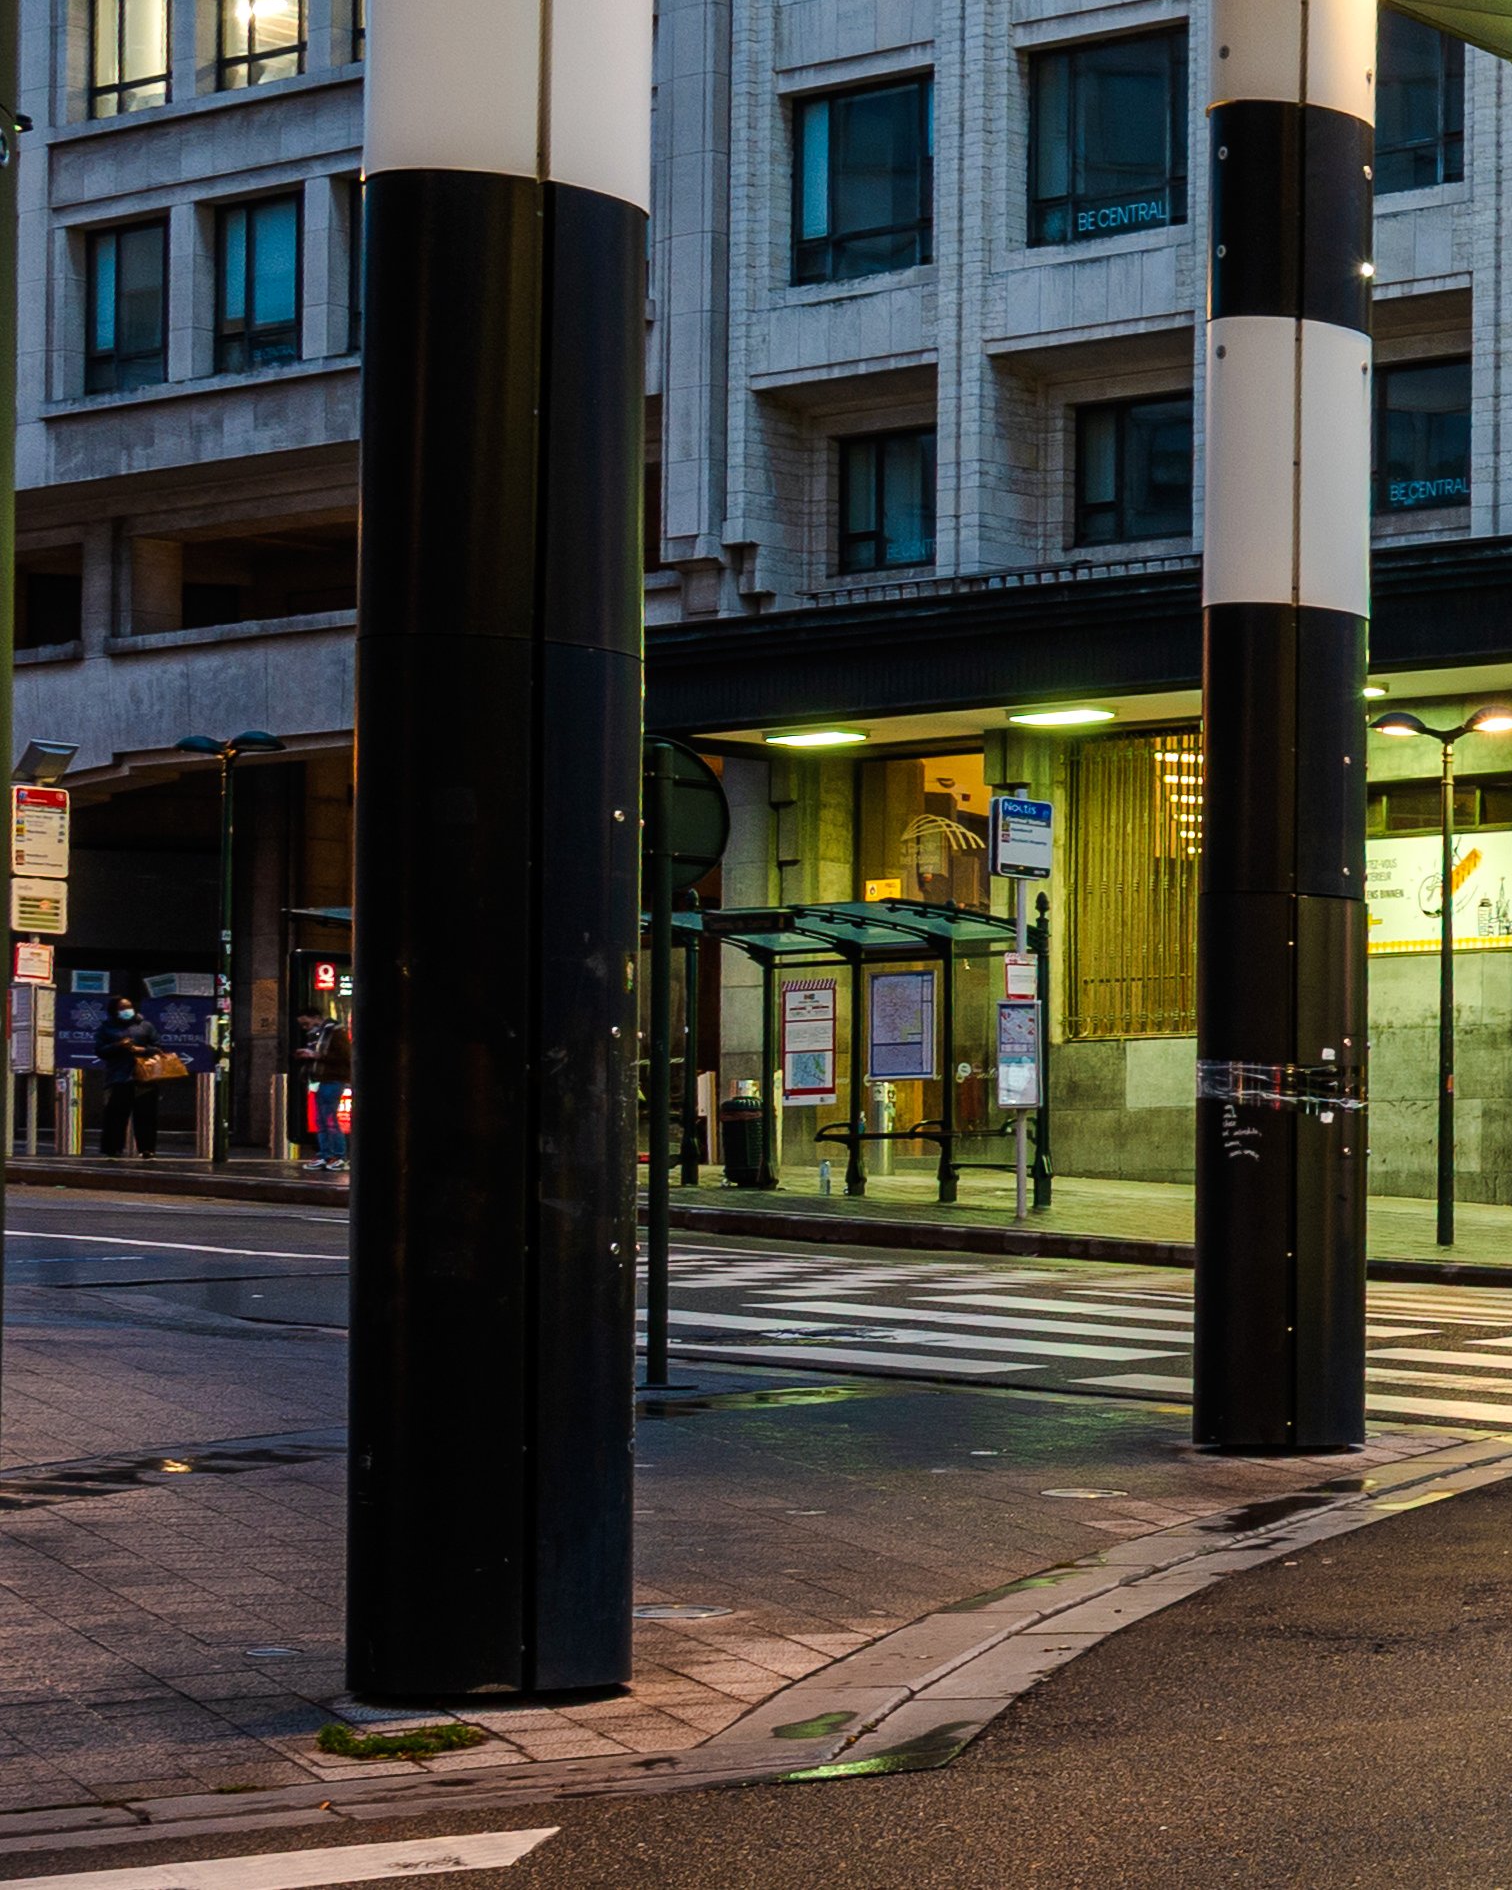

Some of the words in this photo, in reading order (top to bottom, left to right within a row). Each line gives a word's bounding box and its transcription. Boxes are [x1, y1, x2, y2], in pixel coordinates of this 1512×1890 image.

[1078, 212, 1096, 231] BE
[1098, 201, 1167, 228] CENTRAL
[1390, 485, 1407, 501] BE
[1408, 477, 1470, 499] CENTRAL
